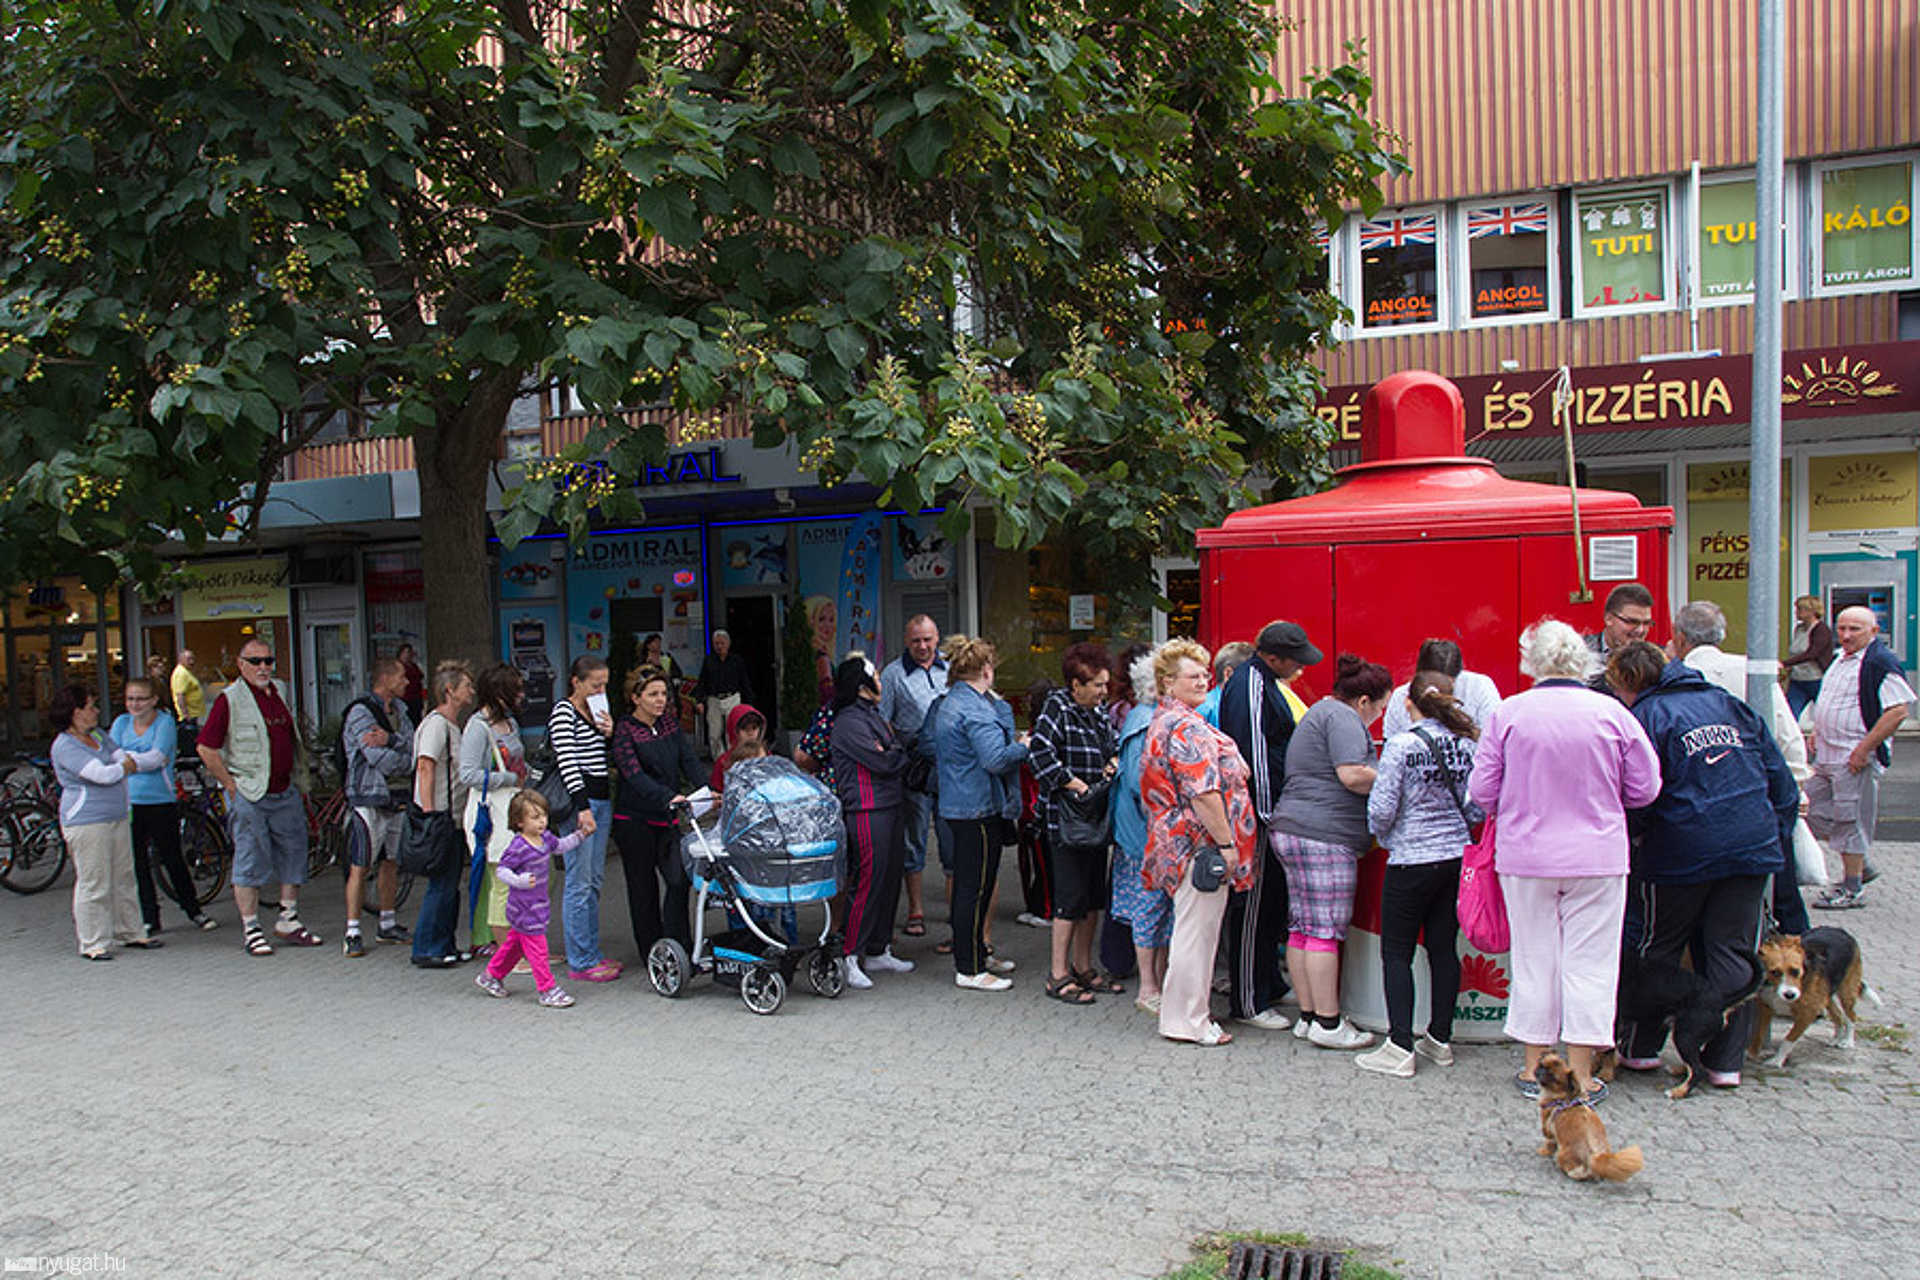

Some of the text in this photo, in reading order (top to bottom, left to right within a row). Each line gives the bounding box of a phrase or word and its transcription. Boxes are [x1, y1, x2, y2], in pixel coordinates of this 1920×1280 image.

[1823, 200, 1911, 234] KÁLÓ
[1590, 233, 1654, 257] TUTI
[1707, 282, 1742, 294] TUTI
[1825, 271, 1860, 283] TUTI
[1367, 295, 1433, 314] ANGOL
[1476, 285, 1544, 303] ANGOL
[1483, 380, 1535, 431] ÉS
[1551, 368, 1734, 427] PIZZÉRIA
[573, 537, 697, 562] ADMIRAL
[1700, 530, 1750, 553] PÉKS
[1695, 556, 1750, 581] PIZZÉ
[1453, 1005, 1509, 1021] MSZP
